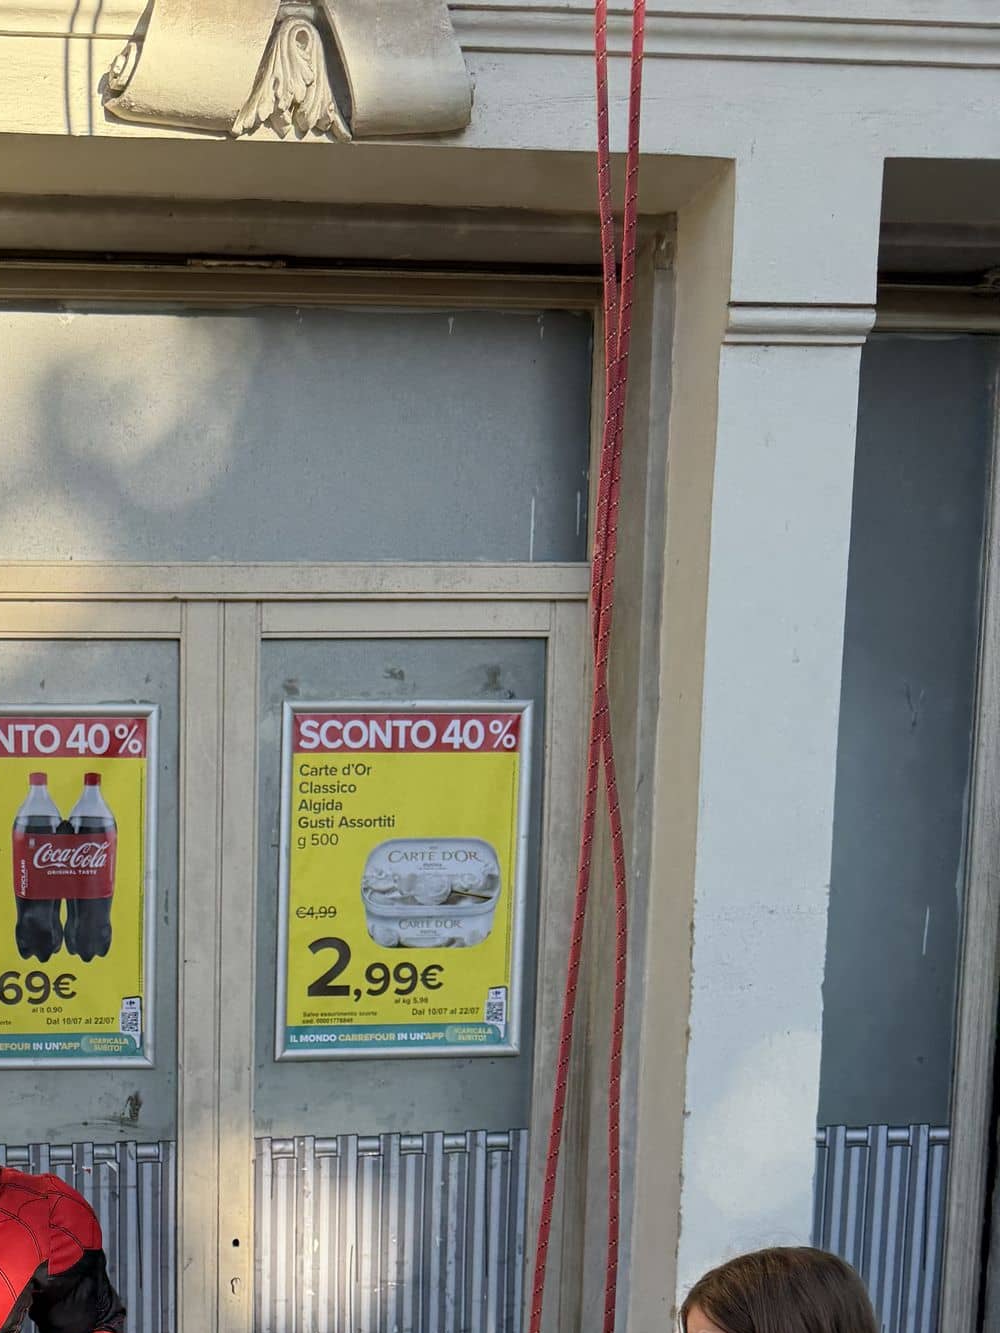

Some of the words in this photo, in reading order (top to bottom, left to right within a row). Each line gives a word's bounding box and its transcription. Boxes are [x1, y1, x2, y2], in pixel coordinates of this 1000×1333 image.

[299, 719, 437, 750] SCONTO
[299, 764, 338, 777] Carte
[341, 763, 372, 776] d'Or
[298, 781, 357, 794] Classico
[297, 799, 343, 813] Algida
[297, 815, 335, 829] Gusti
[338, 814, 396, 829] Assortiti
[297, 837, 306, 849] g
[311, 833, 339, 847] 500
[33, 841, 111, 869] Coca-Cola
[387, 850, 438, 863] CARTE
[441, 850, 481, 862] D'OR
[295, 906, 338, 919] €4,99
[307, 936, 445, 1002] 2,99€
[412, 1008, 425, 1016] Dal
[85, 1017, 92, 1025] al
[94, 1016, 115, 1025] 22/07
[300, 1033, 337, 1043] MONDO
[397, 1032, 408, 1041] IN
[32, 1041, 44, 1050] IN
